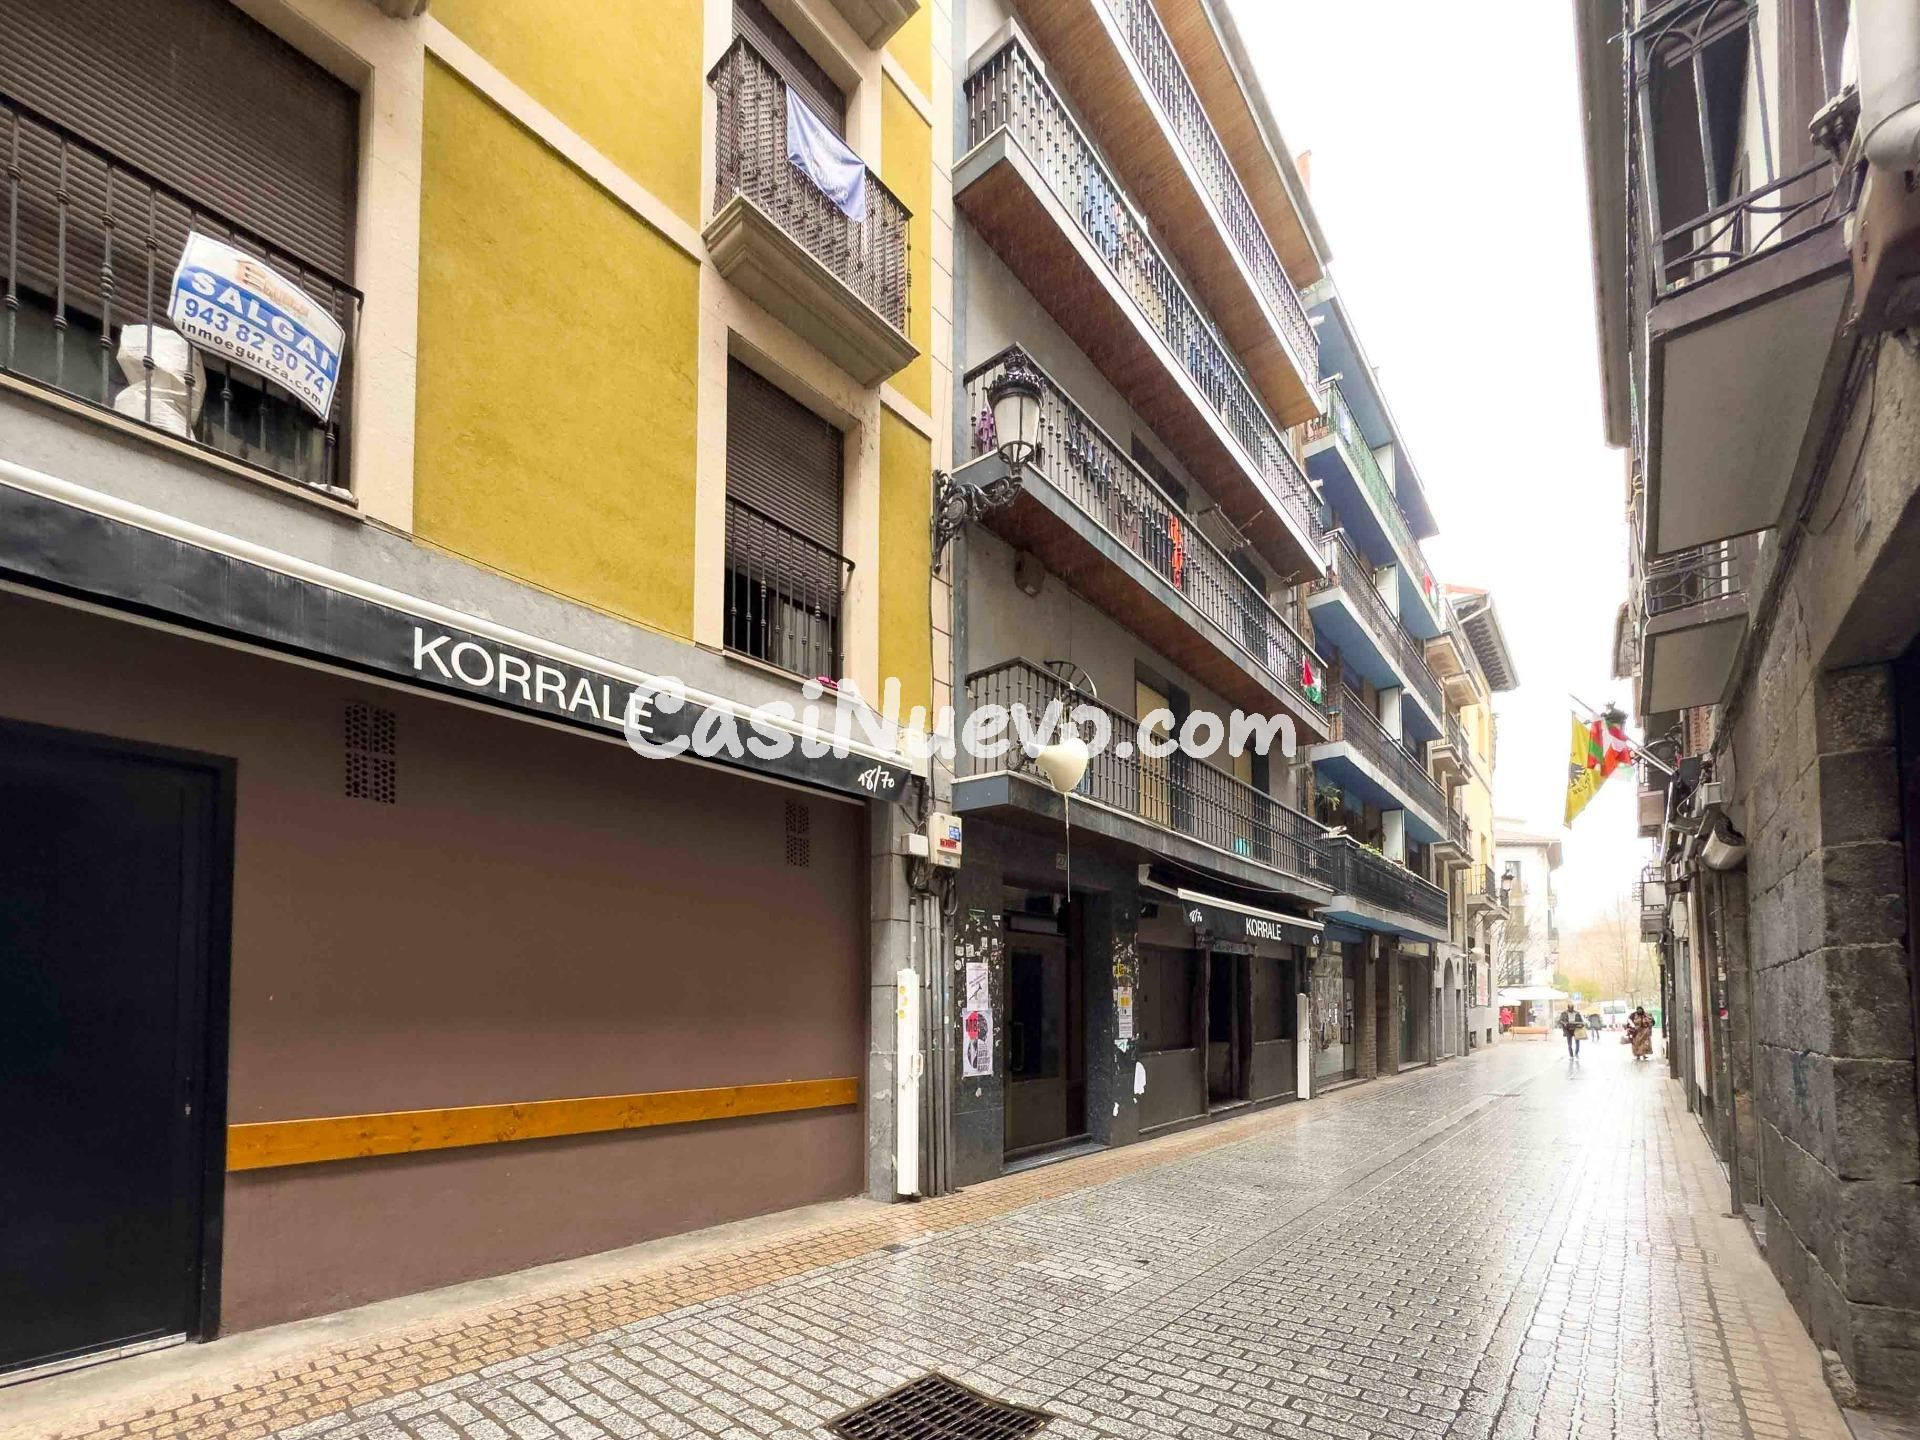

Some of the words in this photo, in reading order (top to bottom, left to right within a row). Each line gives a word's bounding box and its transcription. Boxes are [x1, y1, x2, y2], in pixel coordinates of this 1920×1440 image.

[181, 318, 321, 405] inmoegurtza.com
[185, 298, 229, 332] 943
[235, 324, 266, 350] 82
[272, 344, 298, 371] 90
[305, 363, 325, 393] 74
[413, 626, 654, 734] KORRALE
[857, 765, 895, 793] 18/70
[1245, 917, 1282, 941] KORRALE
